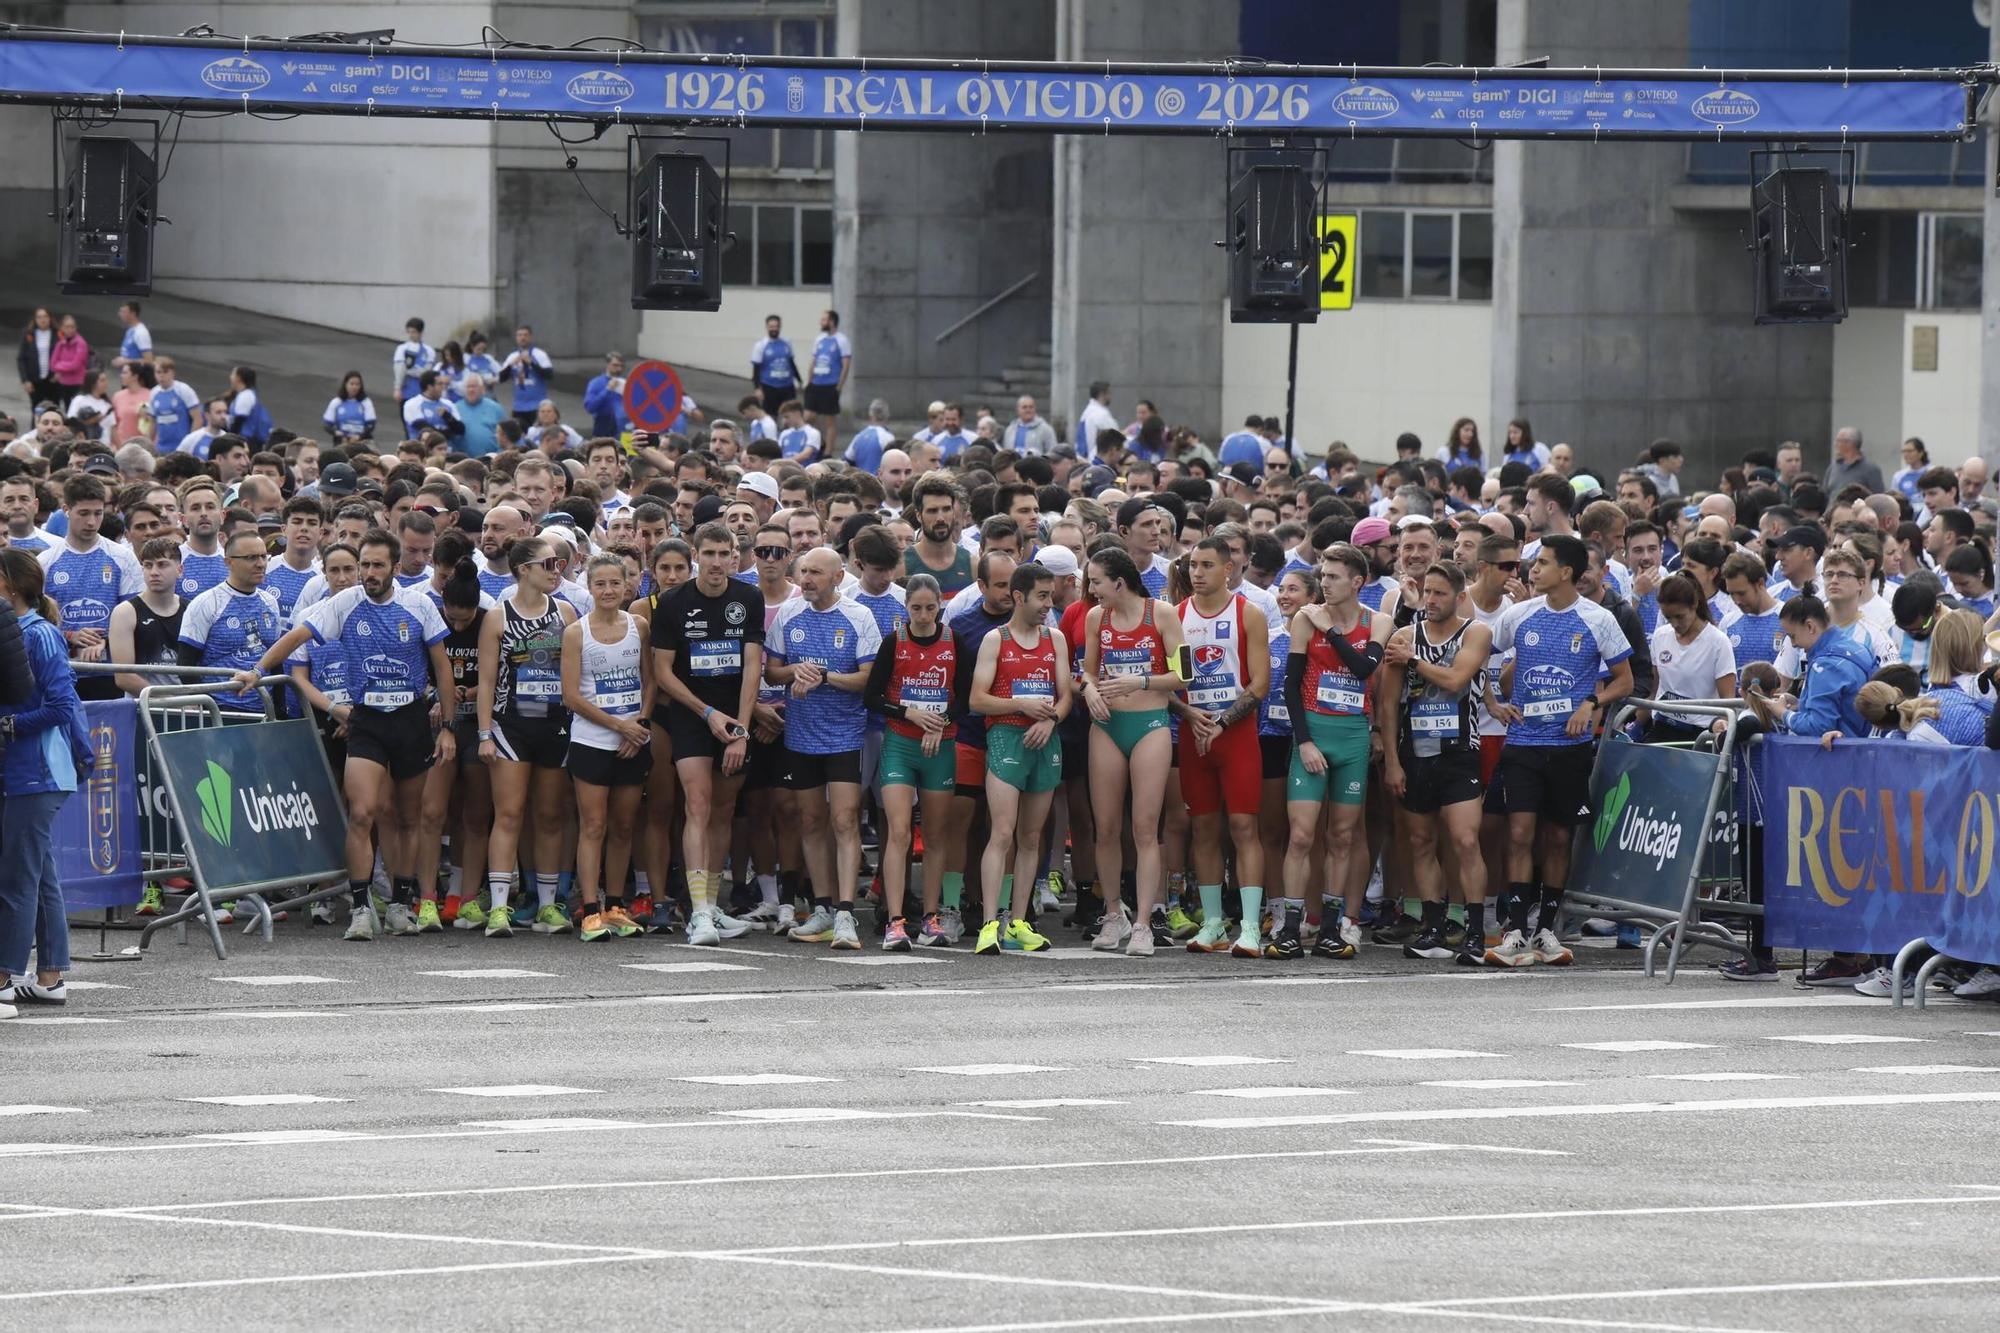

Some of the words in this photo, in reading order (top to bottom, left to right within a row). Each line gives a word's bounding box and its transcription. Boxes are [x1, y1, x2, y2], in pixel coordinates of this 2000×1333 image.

[206, 68, 267, 84] ASTURIANA
[392, 65, 430, 81] DIGI
[512, 69, 552, 80] OVIEDO
[330, 82, 357, 94] alsa
[571, 80, 630, 96] ASTURIANA
[665, 72, 766, 112] 1926
[824, 76, 947, 116] REAL
[955, 78, 1143, 120] OVIEDO
[1518, 89, 1556, 104] DIGI
[1638, 90, 1678, 100] OVIEDO
[1196, 82, 1310, 121] 2026
[1337, 96, 1395, 112] ASTURIANA
[1457, 107, 1484, 119] alsa
[1696, 101, 1755, 115] ASTURIANA
[701, 642, 733, 650] MARCHA
[1112, 650, 1143, 658] MARCHA
[799, 656, 829, 665] MARCHA
[527, 669, 556, 677] MARCHA
[919, 671, 940, 679] Patria
[605, 678, 635, 689] MARCHA
[1196, 675, 1227, 684] MARCHA
[1330, 676, 1360, 687] MARCHA
[542, 683, 558, 693] 150
[1021, 681, 1050, 690] MARCHA
[910, 688, 941, 697] MARCHA
[1214, 690, 1228, 701] 60
[1531, 687, 1561, 698] MARCHA
[389, 694, 409, 704] 560
[1418, 703, 1450, 712] MARCHA
[239, 780, 320, 841] Unicaja
[1618, 804, 1683, 871] Unicaja
[1786, 786, 1947, 908] REAL
